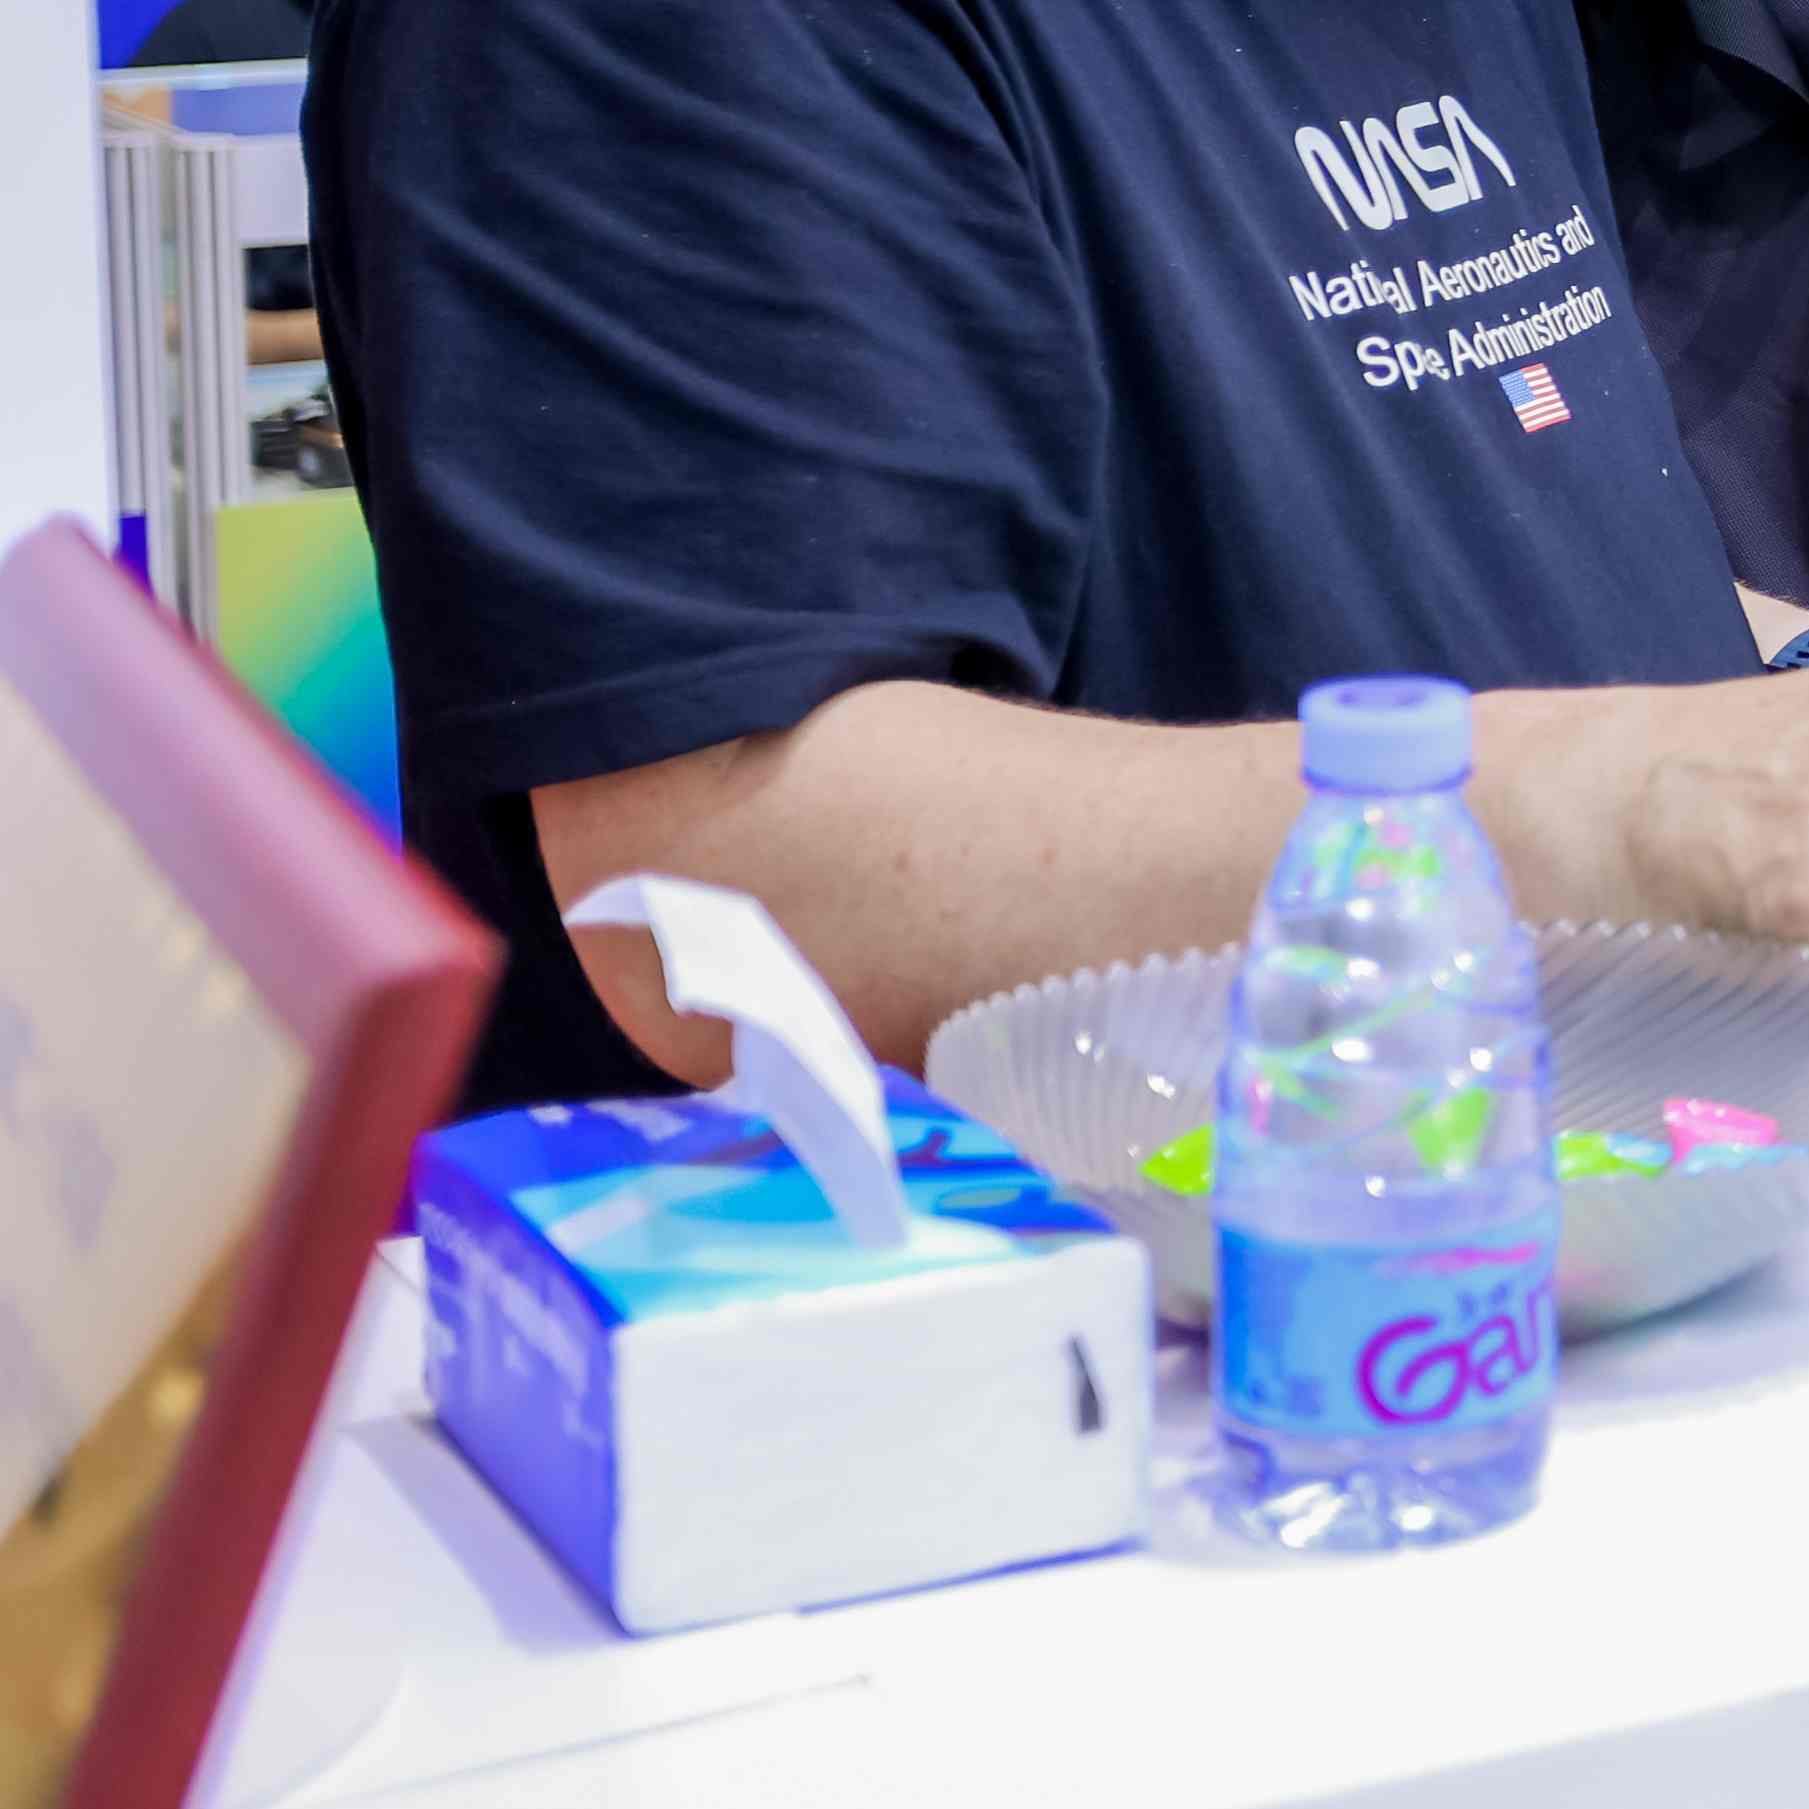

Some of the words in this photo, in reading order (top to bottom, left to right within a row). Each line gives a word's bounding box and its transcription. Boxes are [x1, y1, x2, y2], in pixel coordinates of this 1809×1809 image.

[1293, 94, 1517, 231] NASA
[1288, 258, 1418, 322] Natial
[1555, 204, 1597, 259] and
[1355, 335, 1451, 392] Spe
[1448, 284, 1613, 378] Administration
